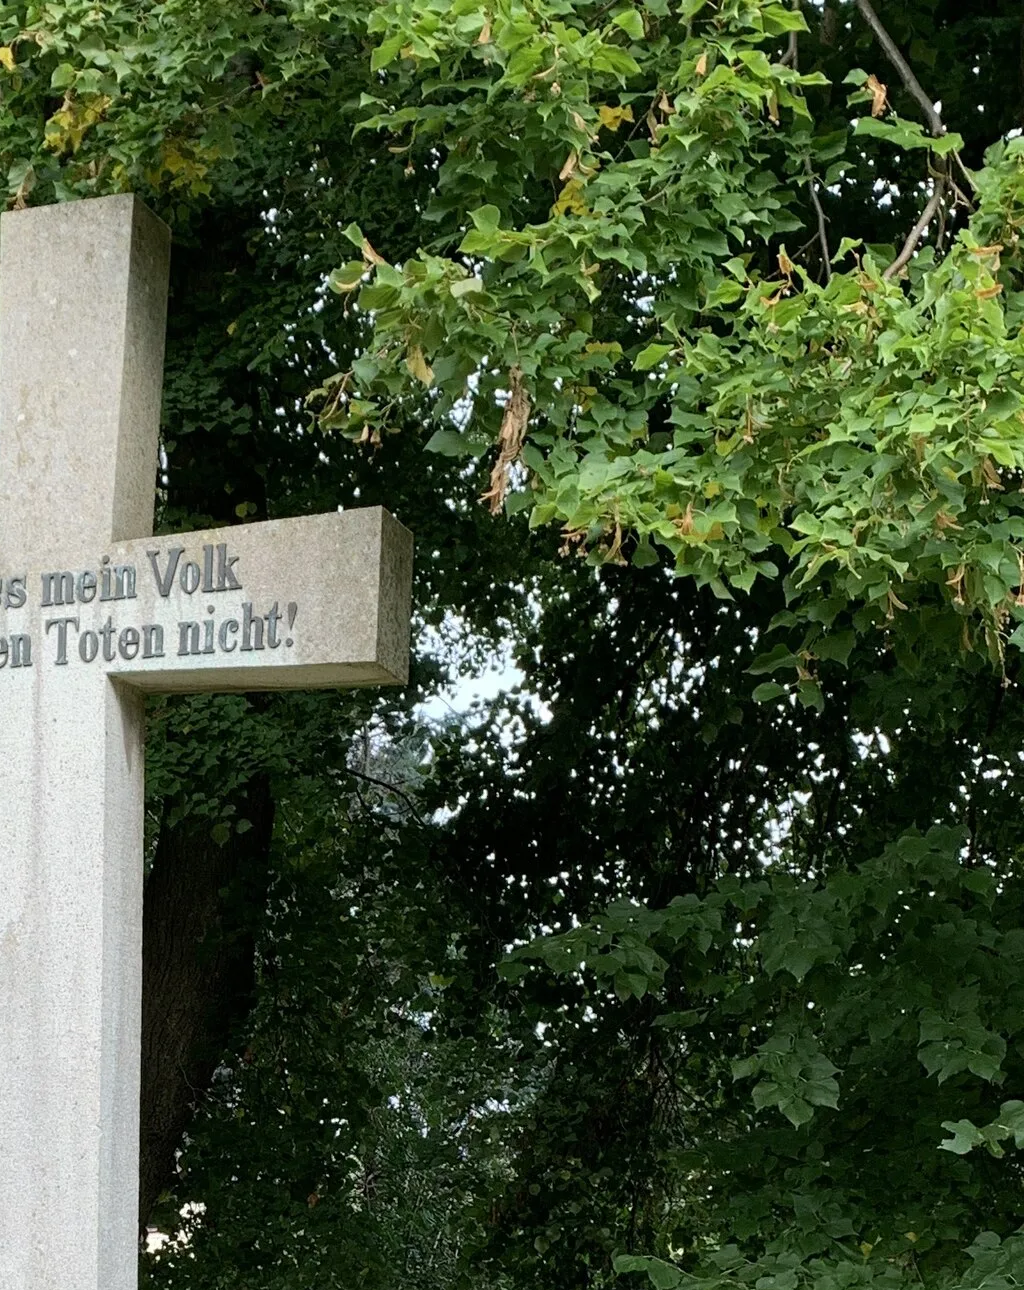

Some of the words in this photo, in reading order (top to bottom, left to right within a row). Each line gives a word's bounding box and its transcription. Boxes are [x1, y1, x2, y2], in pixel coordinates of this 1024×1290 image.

[40, 555, 137, 607] mein
[146, 543, 243, 598] Volk
[44, 614, 144, 666] Toten
[176, 602, 298, 656] nicht!
